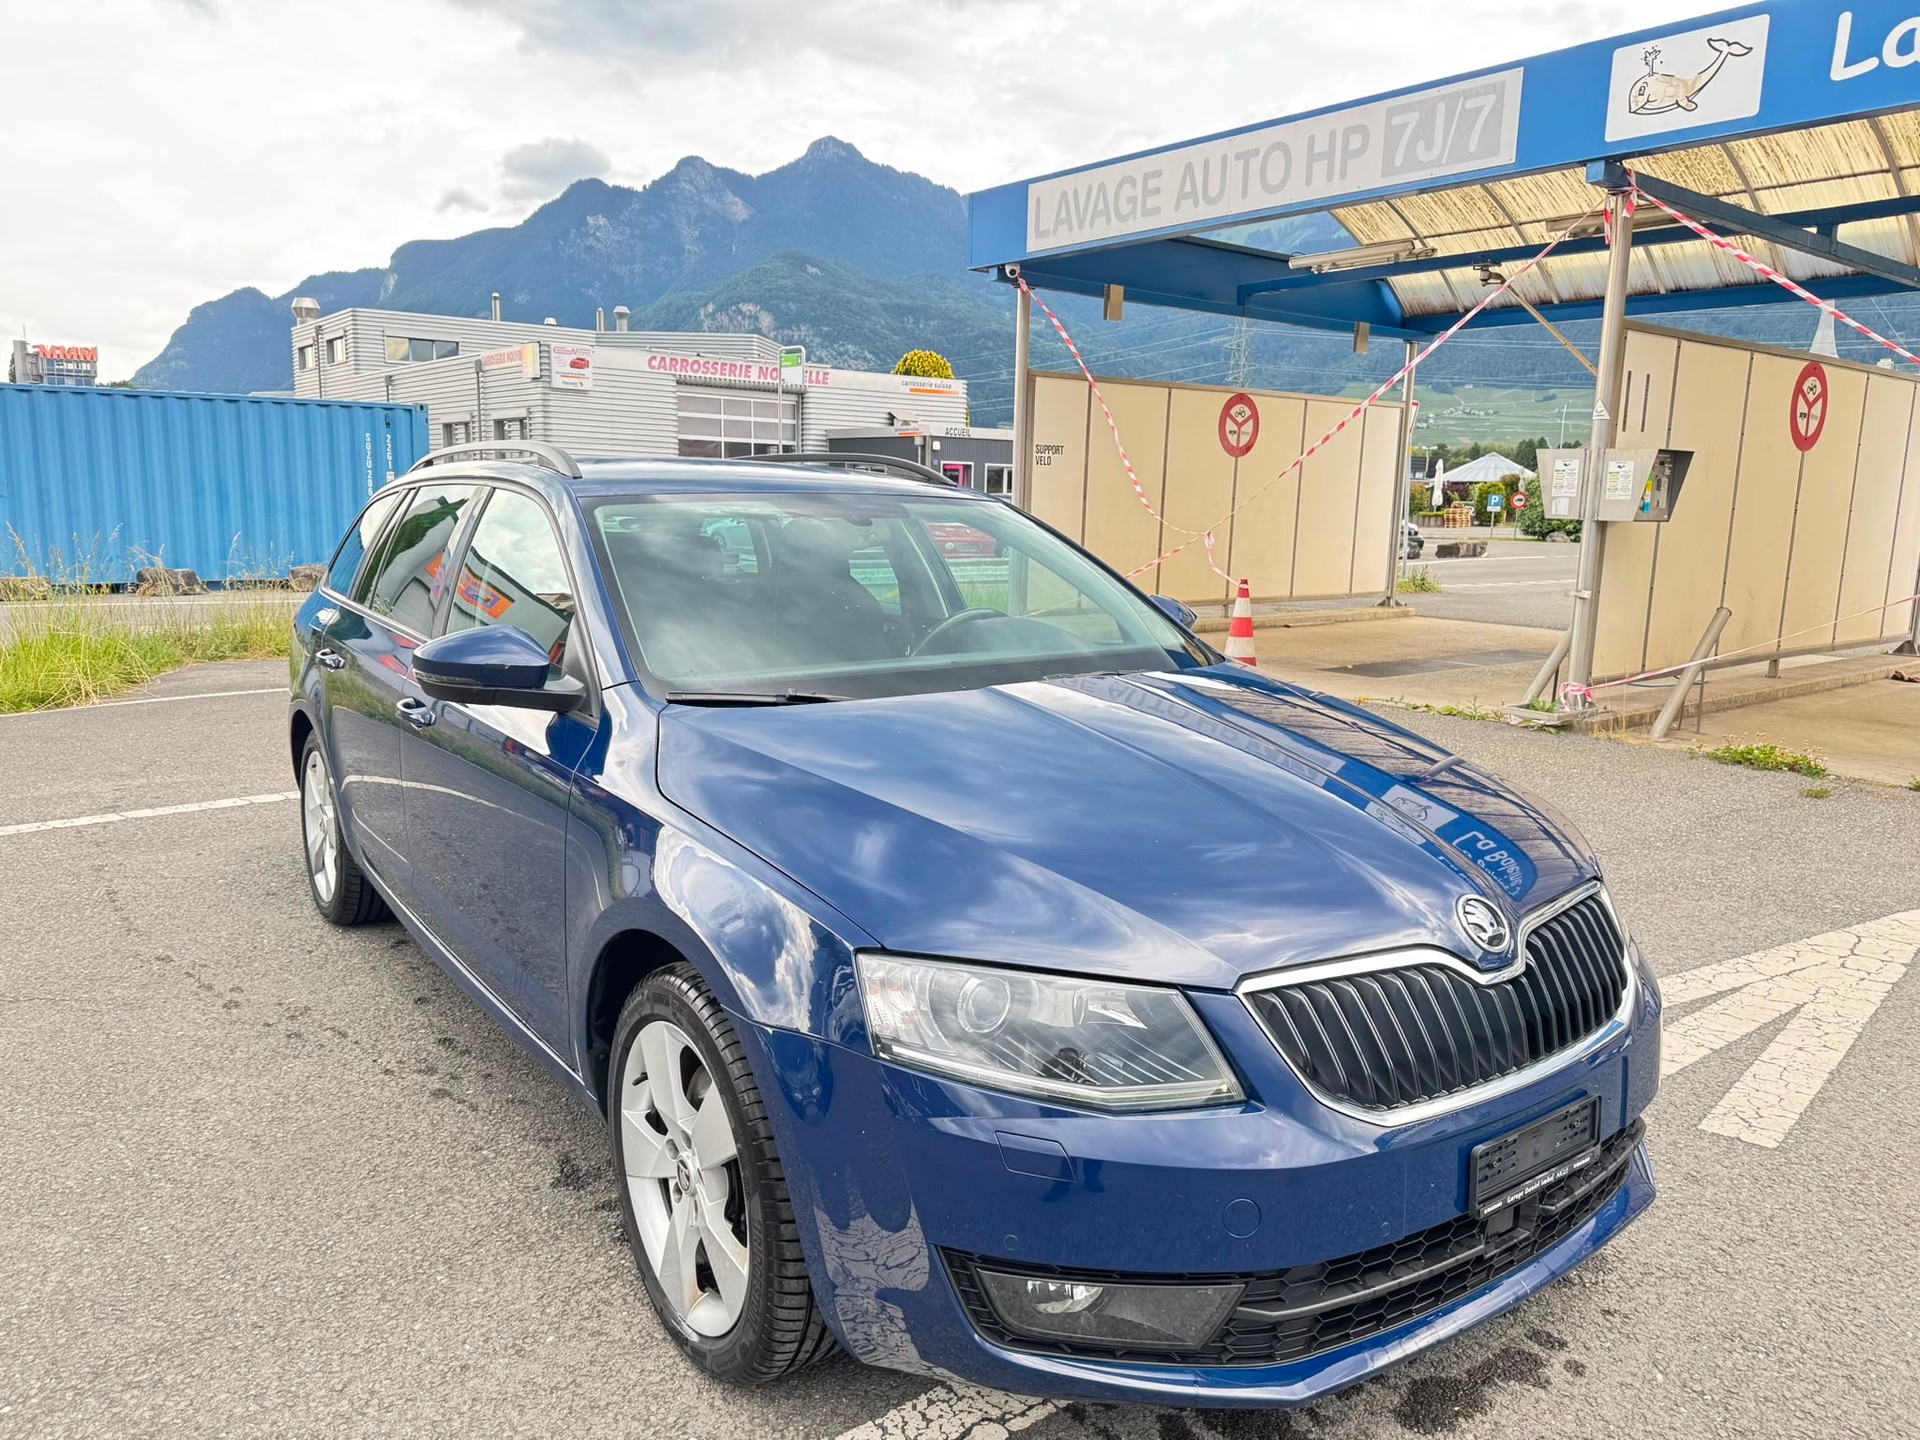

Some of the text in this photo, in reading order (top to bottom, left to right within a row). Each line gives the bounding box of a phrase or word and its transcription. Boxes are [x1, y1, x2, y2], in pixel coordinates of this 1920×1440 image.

[1034, 92, 1498, 239] LAVAGE AUTO HP 7J/7
[647, 355, 752, 379] CARROSSERIE
[945, 427, 971, 437] ACCUEIL
[1035, 444, 1064, 455] SUPPORT
[1035, 455, 1051, 465] VELO
[1492, 496, 1499, 504] P
